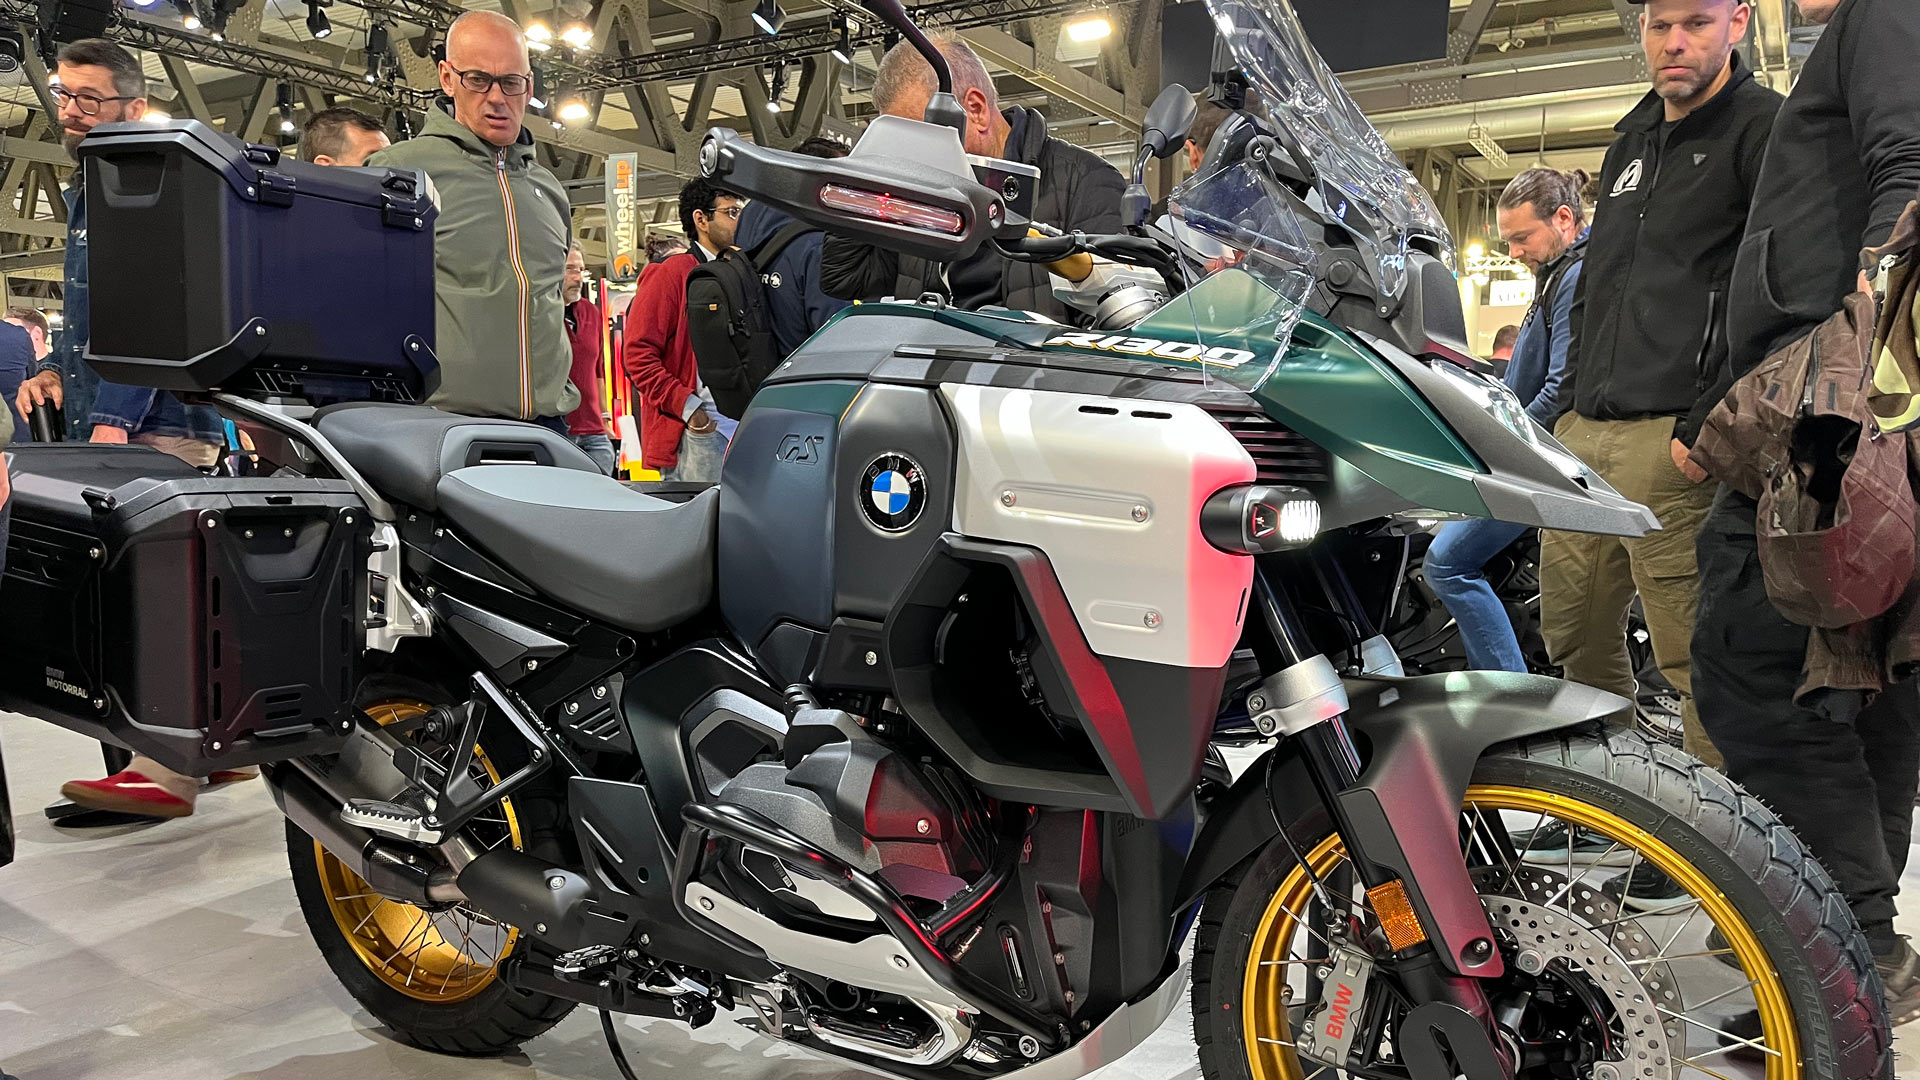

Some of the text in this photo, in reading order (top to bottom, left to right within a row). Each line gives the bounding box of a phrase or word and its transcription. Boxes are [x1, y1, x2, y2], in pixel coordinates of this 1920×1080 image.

[613, 160, 632, 255] wheelup
[1042, 332, 1255, 369] R1300
[776, 433, 825, 466] GS
[867, 457, 921, 484] BMW
[1325, 982, 1353, 1040] BMW
